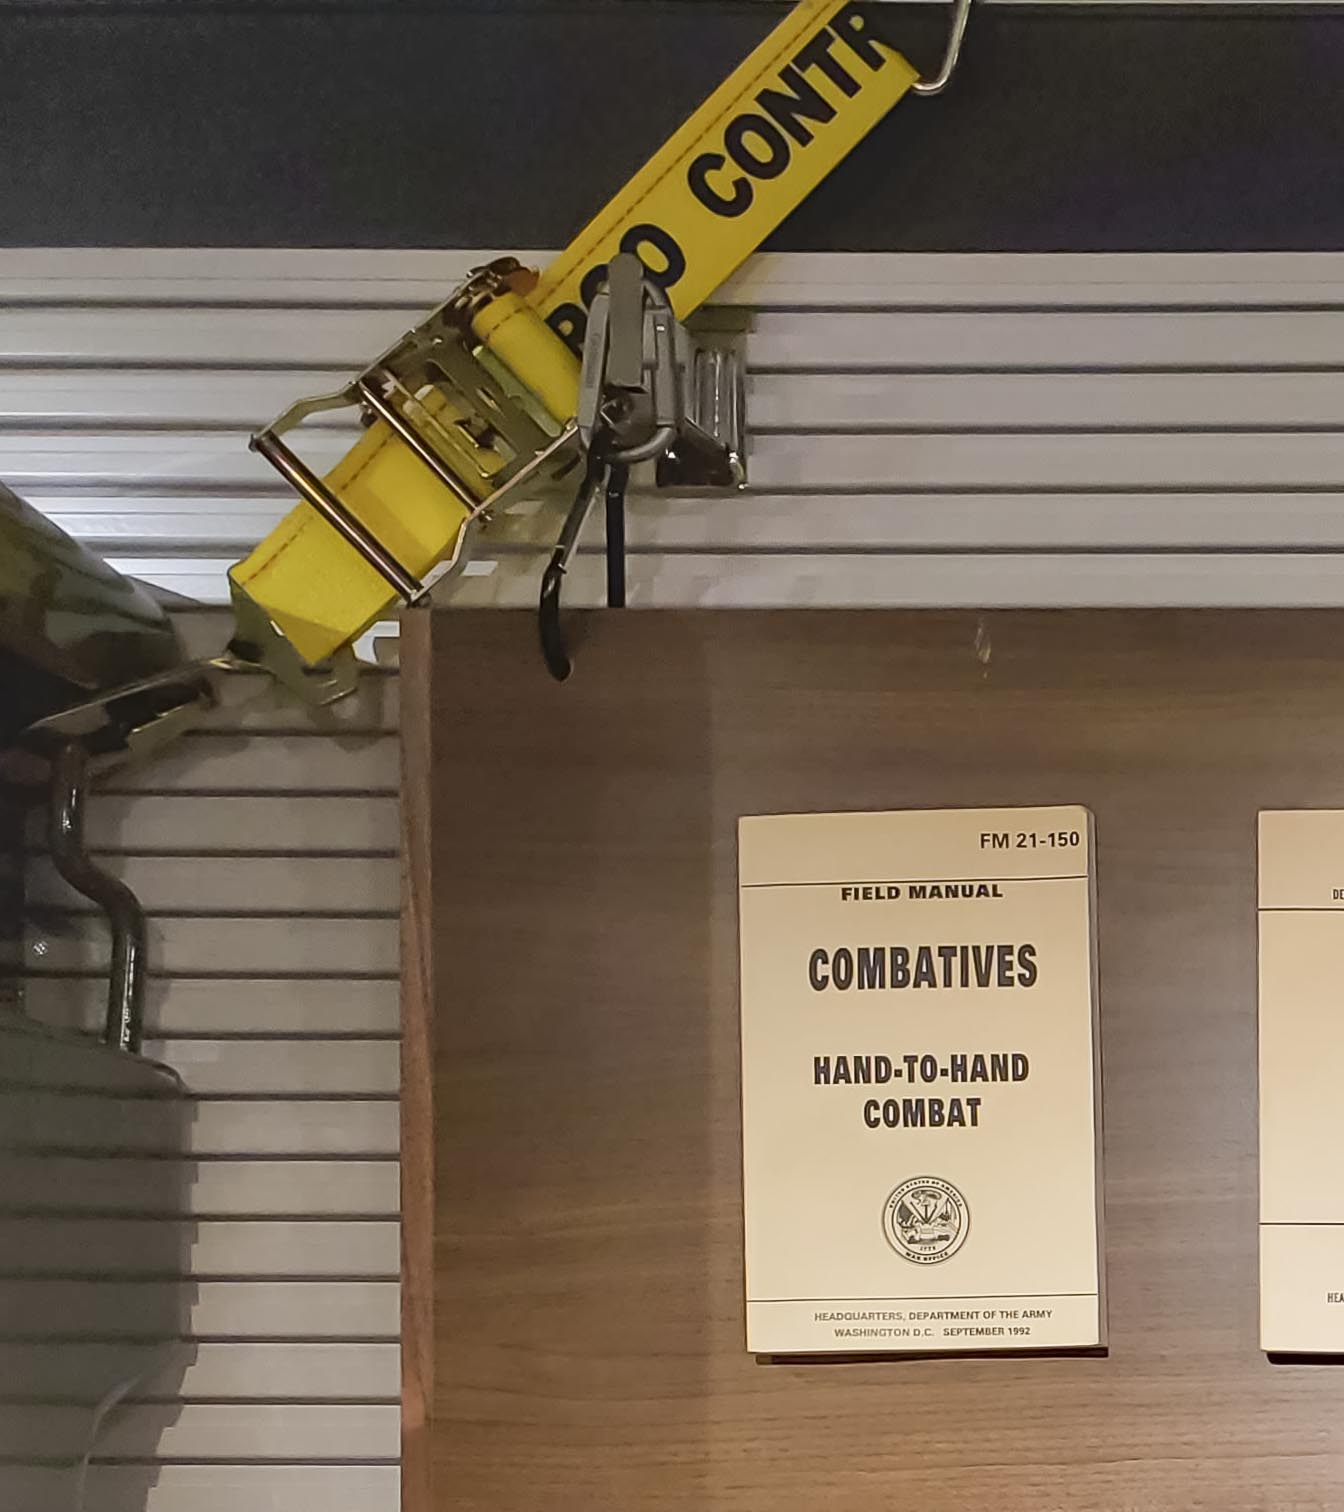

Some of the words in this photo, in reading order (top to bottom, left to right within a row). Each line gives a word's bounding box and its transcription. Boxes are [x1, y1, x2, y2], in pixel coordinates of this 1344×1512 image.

[980, 833, 1009, 848] FM
[1016, 831, 1080, 848] 21-150
[841, 886, 900, 900] FIELD
[909, 884, 1003, 899] MANUAL
[809, 944, 1037, 990] COMBATIVES
[814, 1053, 1029, 1084] HAND-TO-HAND
[863, 1098, 981, 1129] COMBAT
[909, 1311, 979, 1320] DEPARTMENT
[983, 1311, 995, 1319] OF
[999, 1310, 1019, 1319] THE
[1022, 1309, 1052, 1319] ARMY
[834, 1328, 909, 1337] WASHINGTON
[943, 1327, 1004, 1336] SEPTEMBER
[1008, 1326, 1030, 1335] 1992
